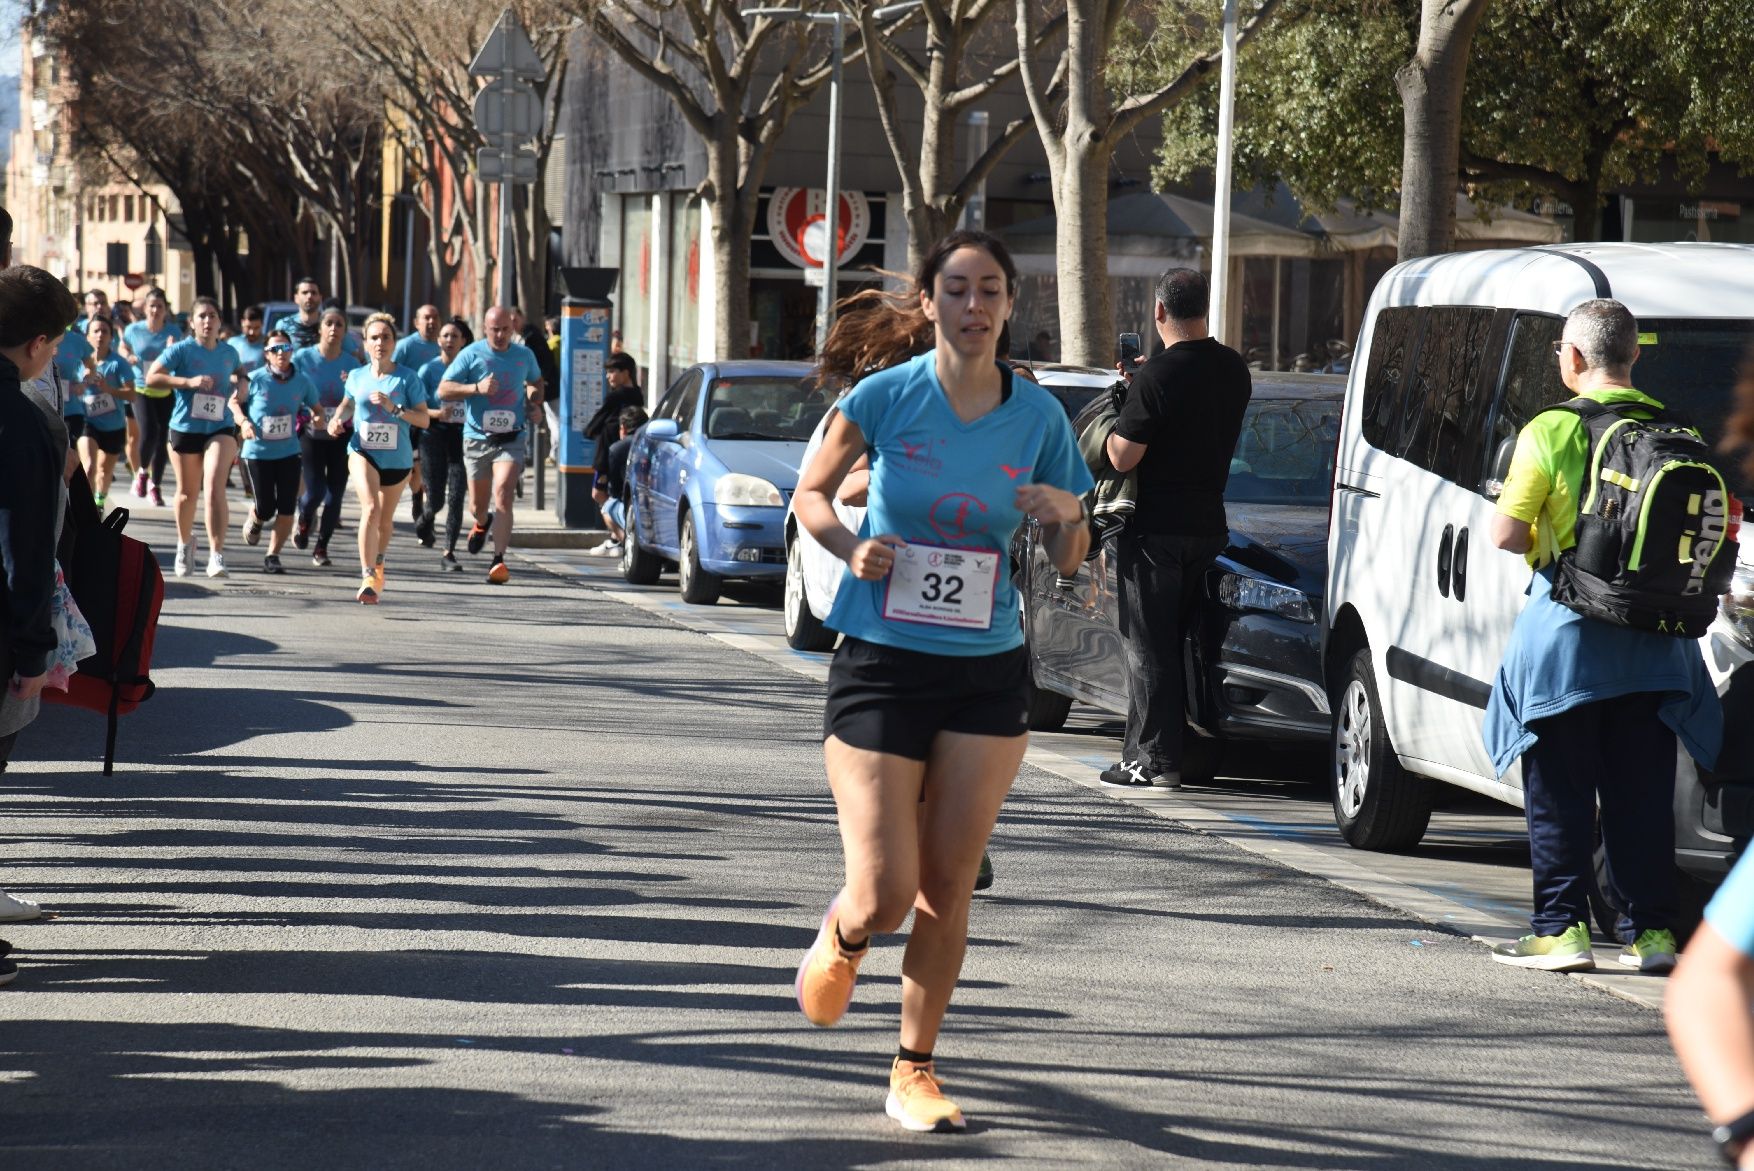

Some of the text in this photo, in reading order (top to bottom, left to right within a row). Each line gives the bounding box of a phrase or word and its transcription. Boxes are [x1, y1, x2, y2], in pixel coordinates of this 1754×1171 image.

[202, 403, 216, 415] 42
[490, 417, 509, 427] 259
[269, 423, 288, 434] 217
[367, 431, 389, 443] 273
[921, 572, 964, 604] 32
